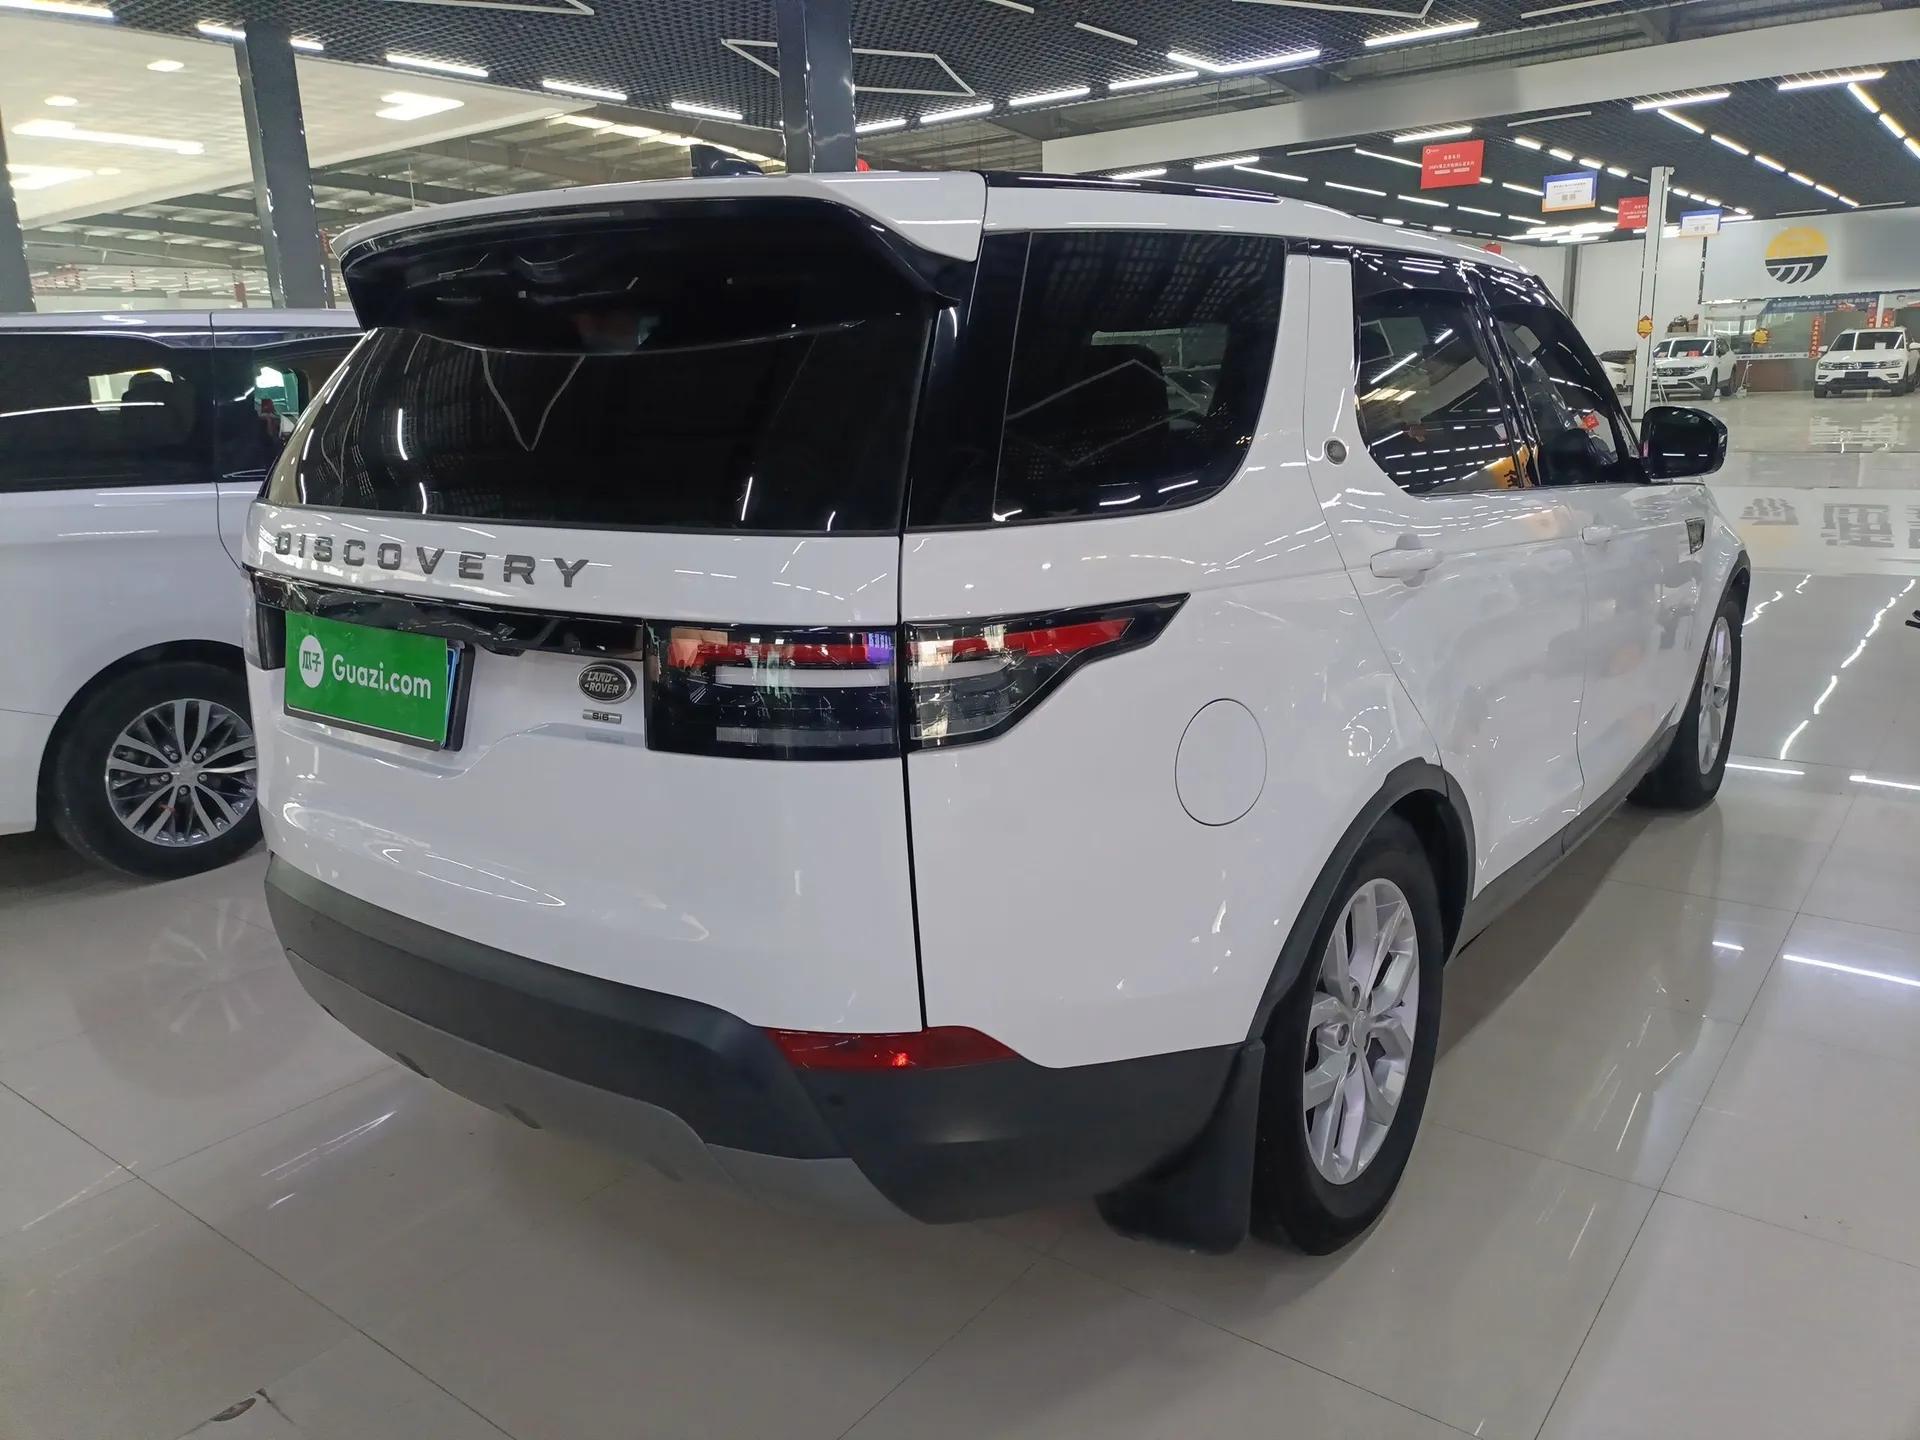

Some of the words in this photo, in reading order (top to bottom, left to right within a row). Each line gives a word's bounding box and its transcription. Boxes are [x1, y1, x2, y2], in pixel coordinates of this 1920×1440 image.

[274, 531, 590, 589] DISCOVERY
[302, 650, 322, 672] 瓜子
[332, 654, 431, 699] Guazi.com
[588, 682, 620, 694] ROVER
